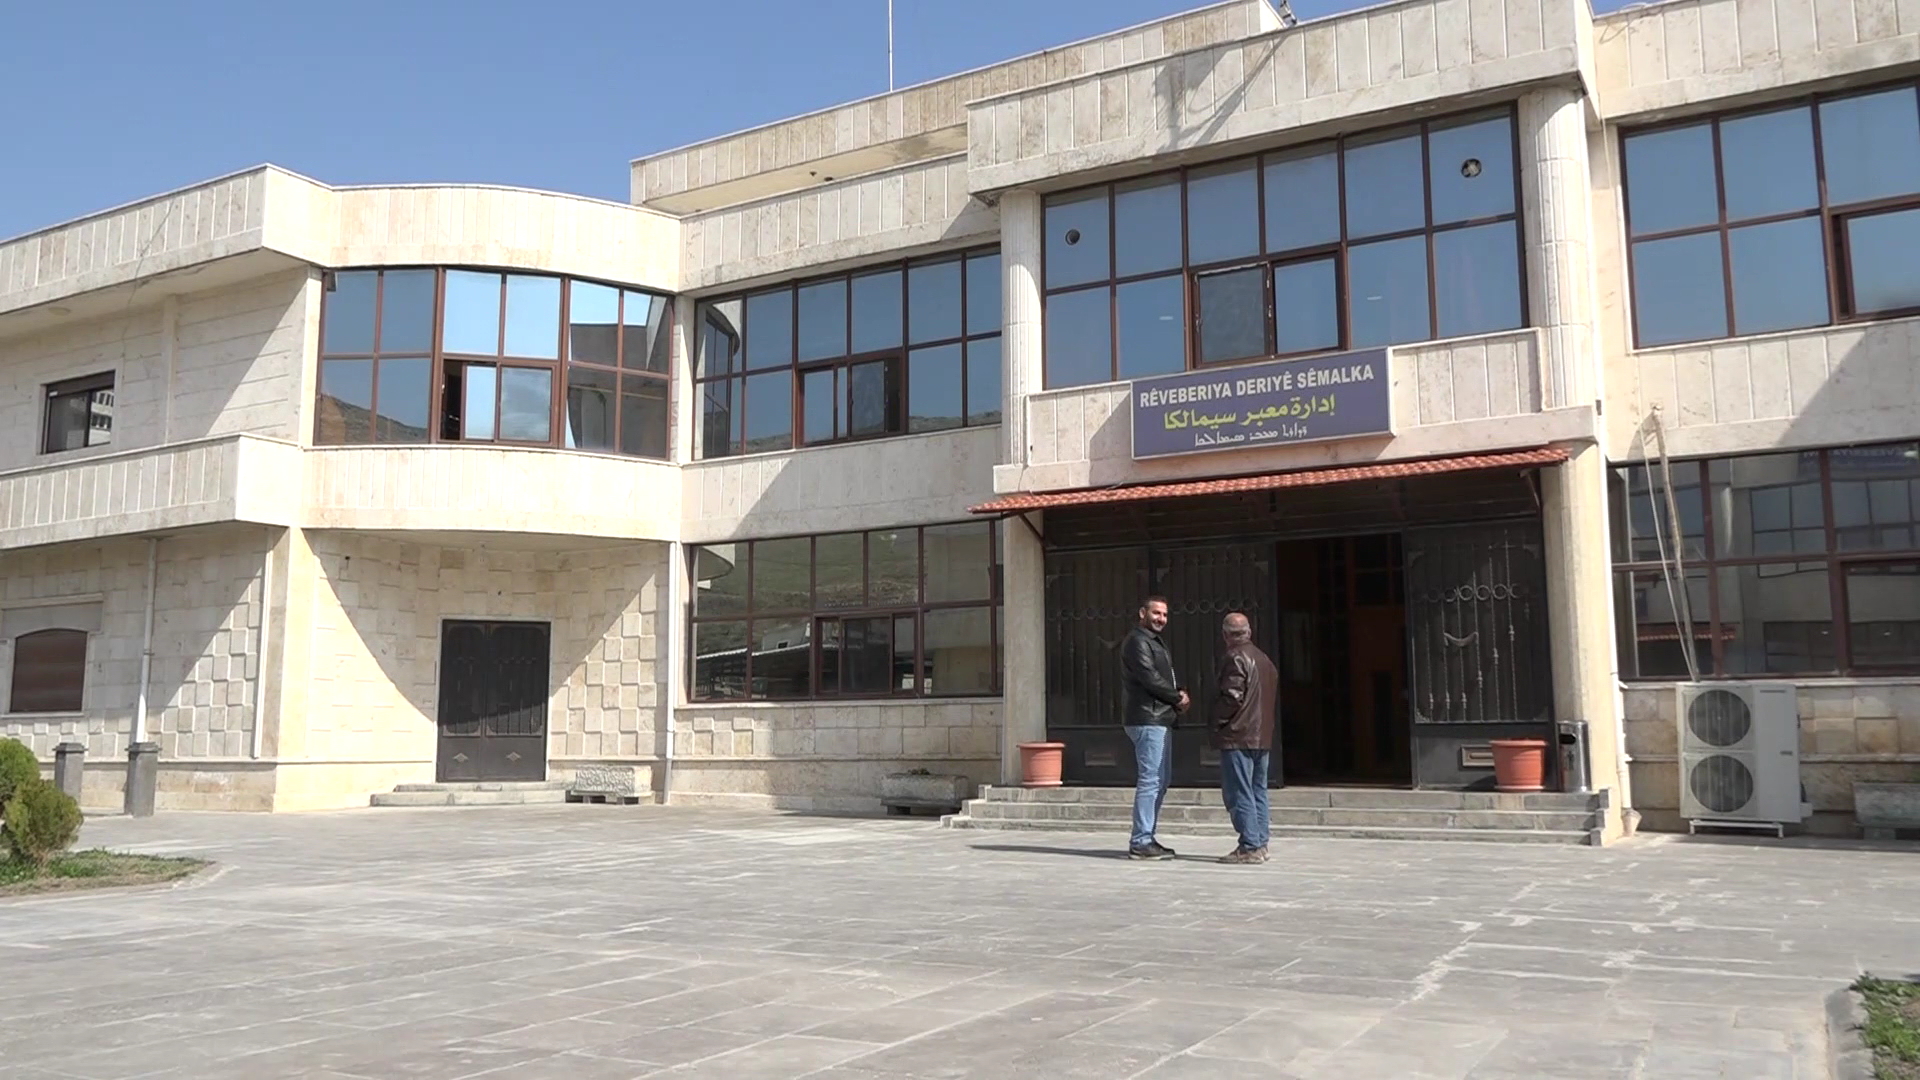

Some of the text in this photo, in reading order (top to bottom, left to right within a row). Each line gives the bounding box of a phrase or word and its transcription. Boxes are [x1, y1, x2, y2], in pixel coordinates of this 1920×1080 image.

[1140, 364, 1374, 408] RÊVEBERIYA DERIYÊ SÊMALKA
[1164, 393, 1335, 429] إدارة معبر سيمالكا
